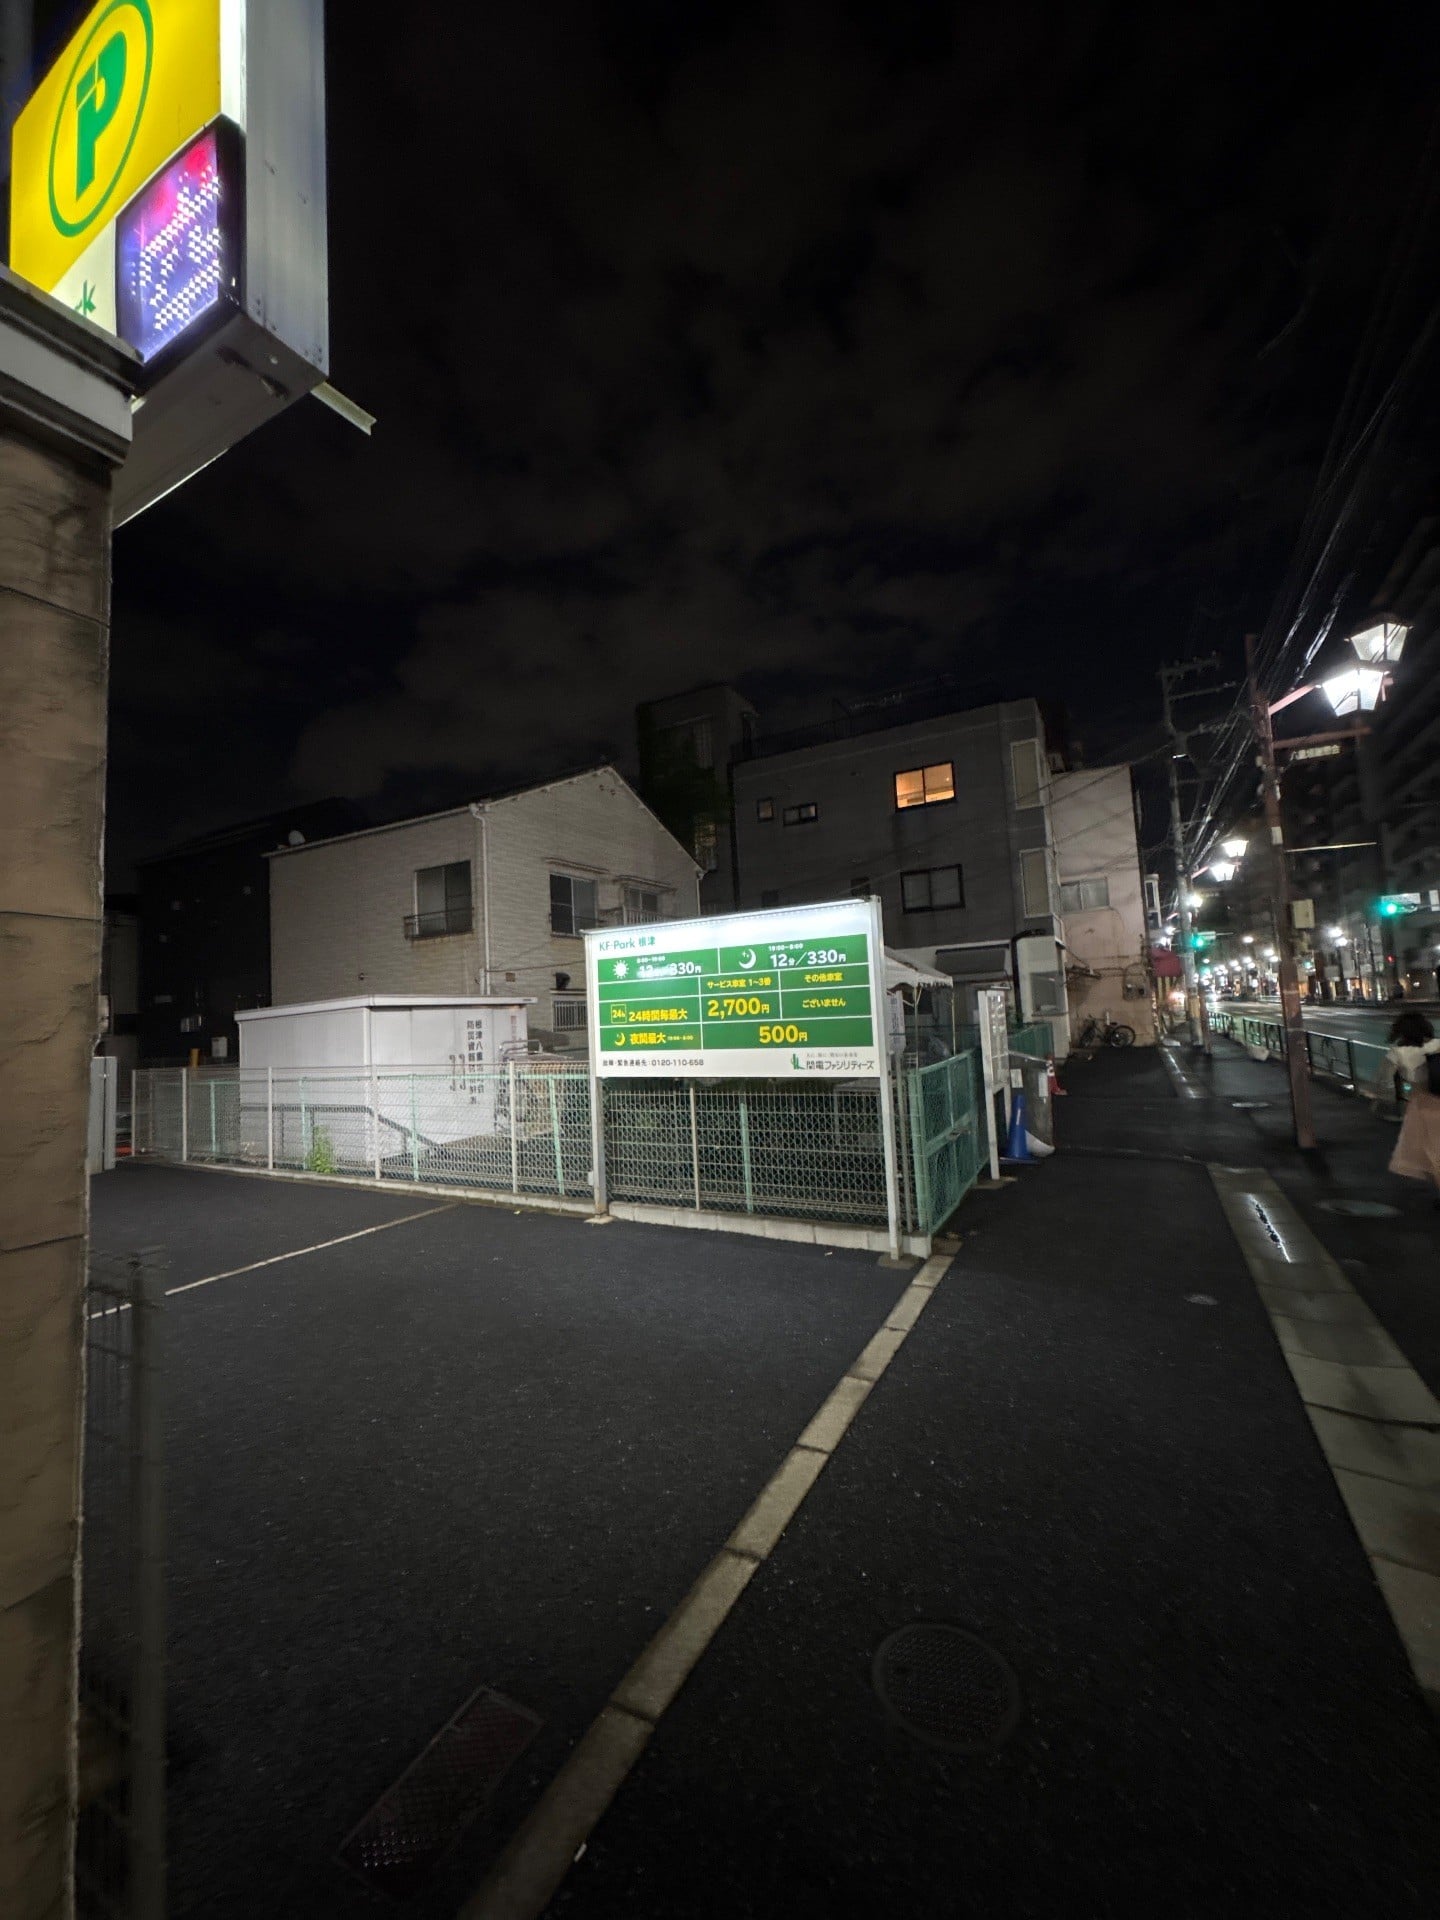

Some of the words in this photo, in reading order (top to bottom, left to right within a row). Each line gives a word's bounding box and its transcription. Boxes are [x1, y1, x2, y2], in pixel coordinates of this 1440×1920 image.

[76, 31, 127, 201] P
[707, 997, 770, 1020] 2,700円
[802, 998, 847, 1008] ございません
[630, 1032, 666, 1045] 夜間最大
[759, 1024, 808, 1044] 500円
